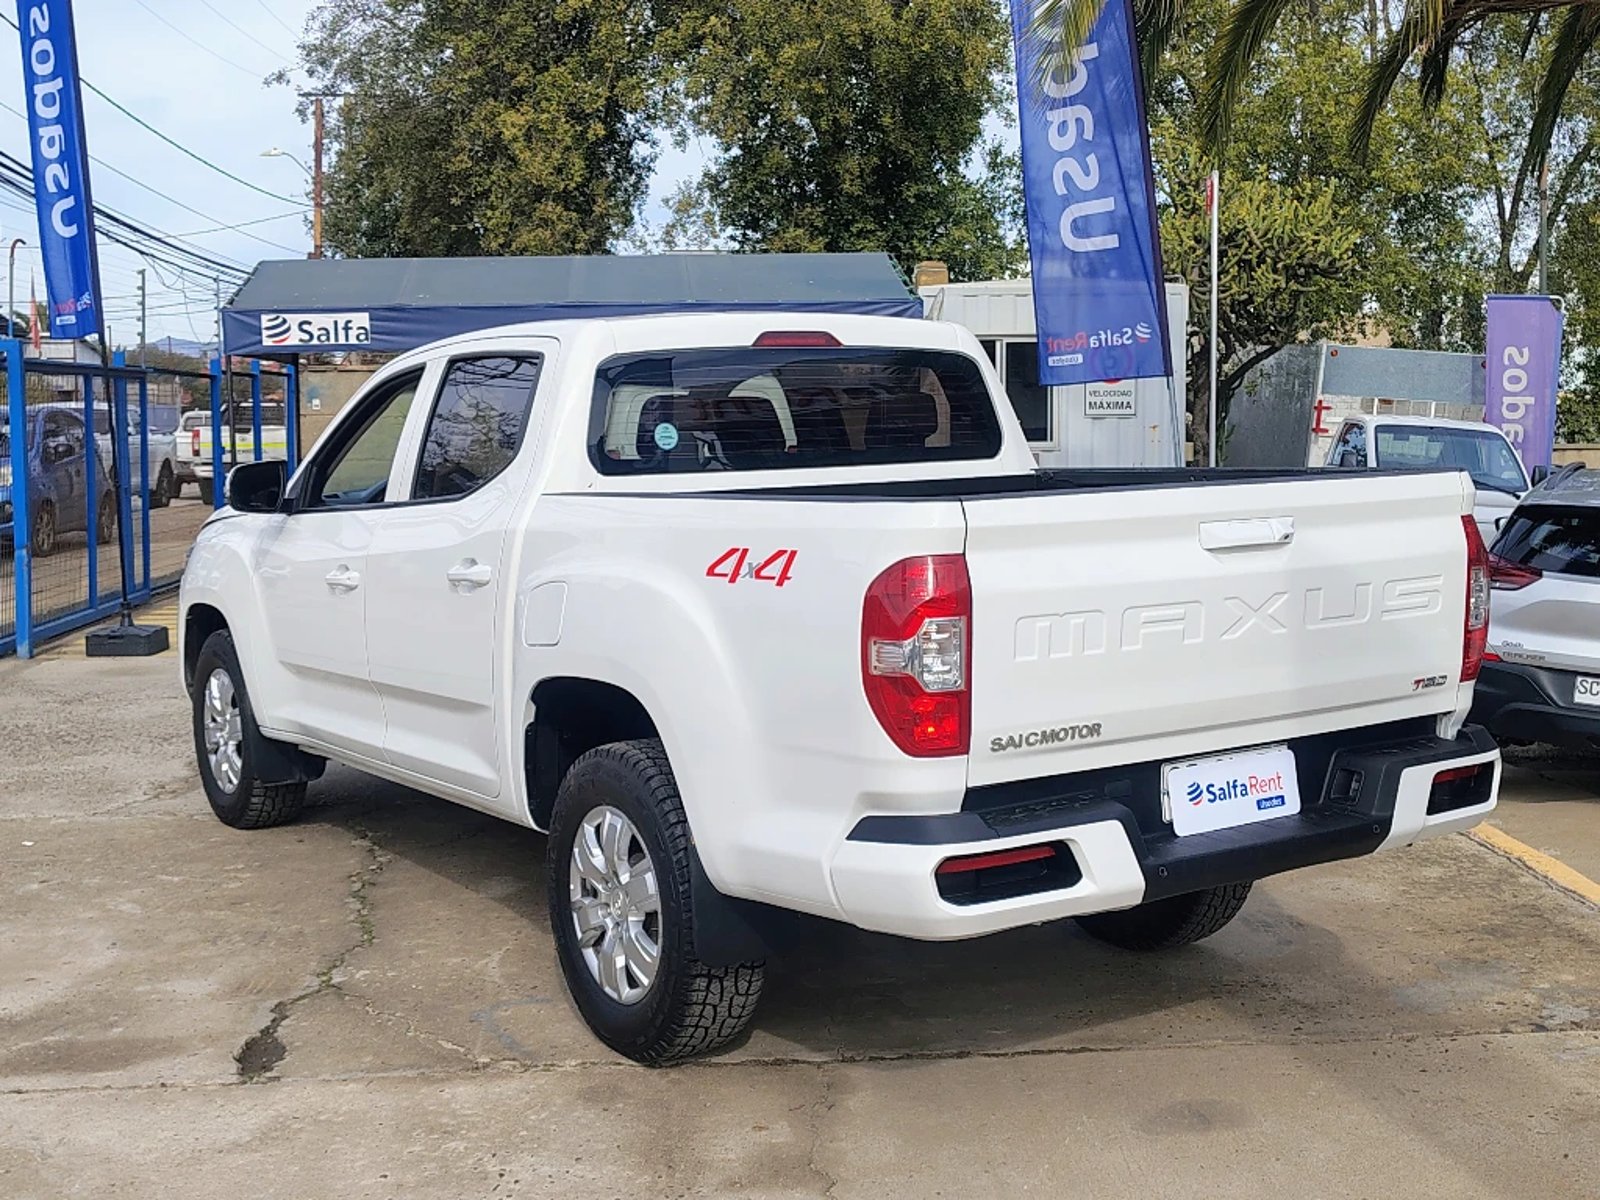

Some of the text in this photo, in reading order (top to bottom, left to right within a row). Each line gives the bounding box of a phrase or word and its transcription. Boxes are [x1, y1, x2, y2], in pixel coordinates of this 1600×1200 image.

[297, 319, 369, 343] Salfa
[1088, 398, 1132, 410] MÁXIMA
[705, 547, 798, 587] 4x4
[1012, 574, 1444, 662] MAXUS
